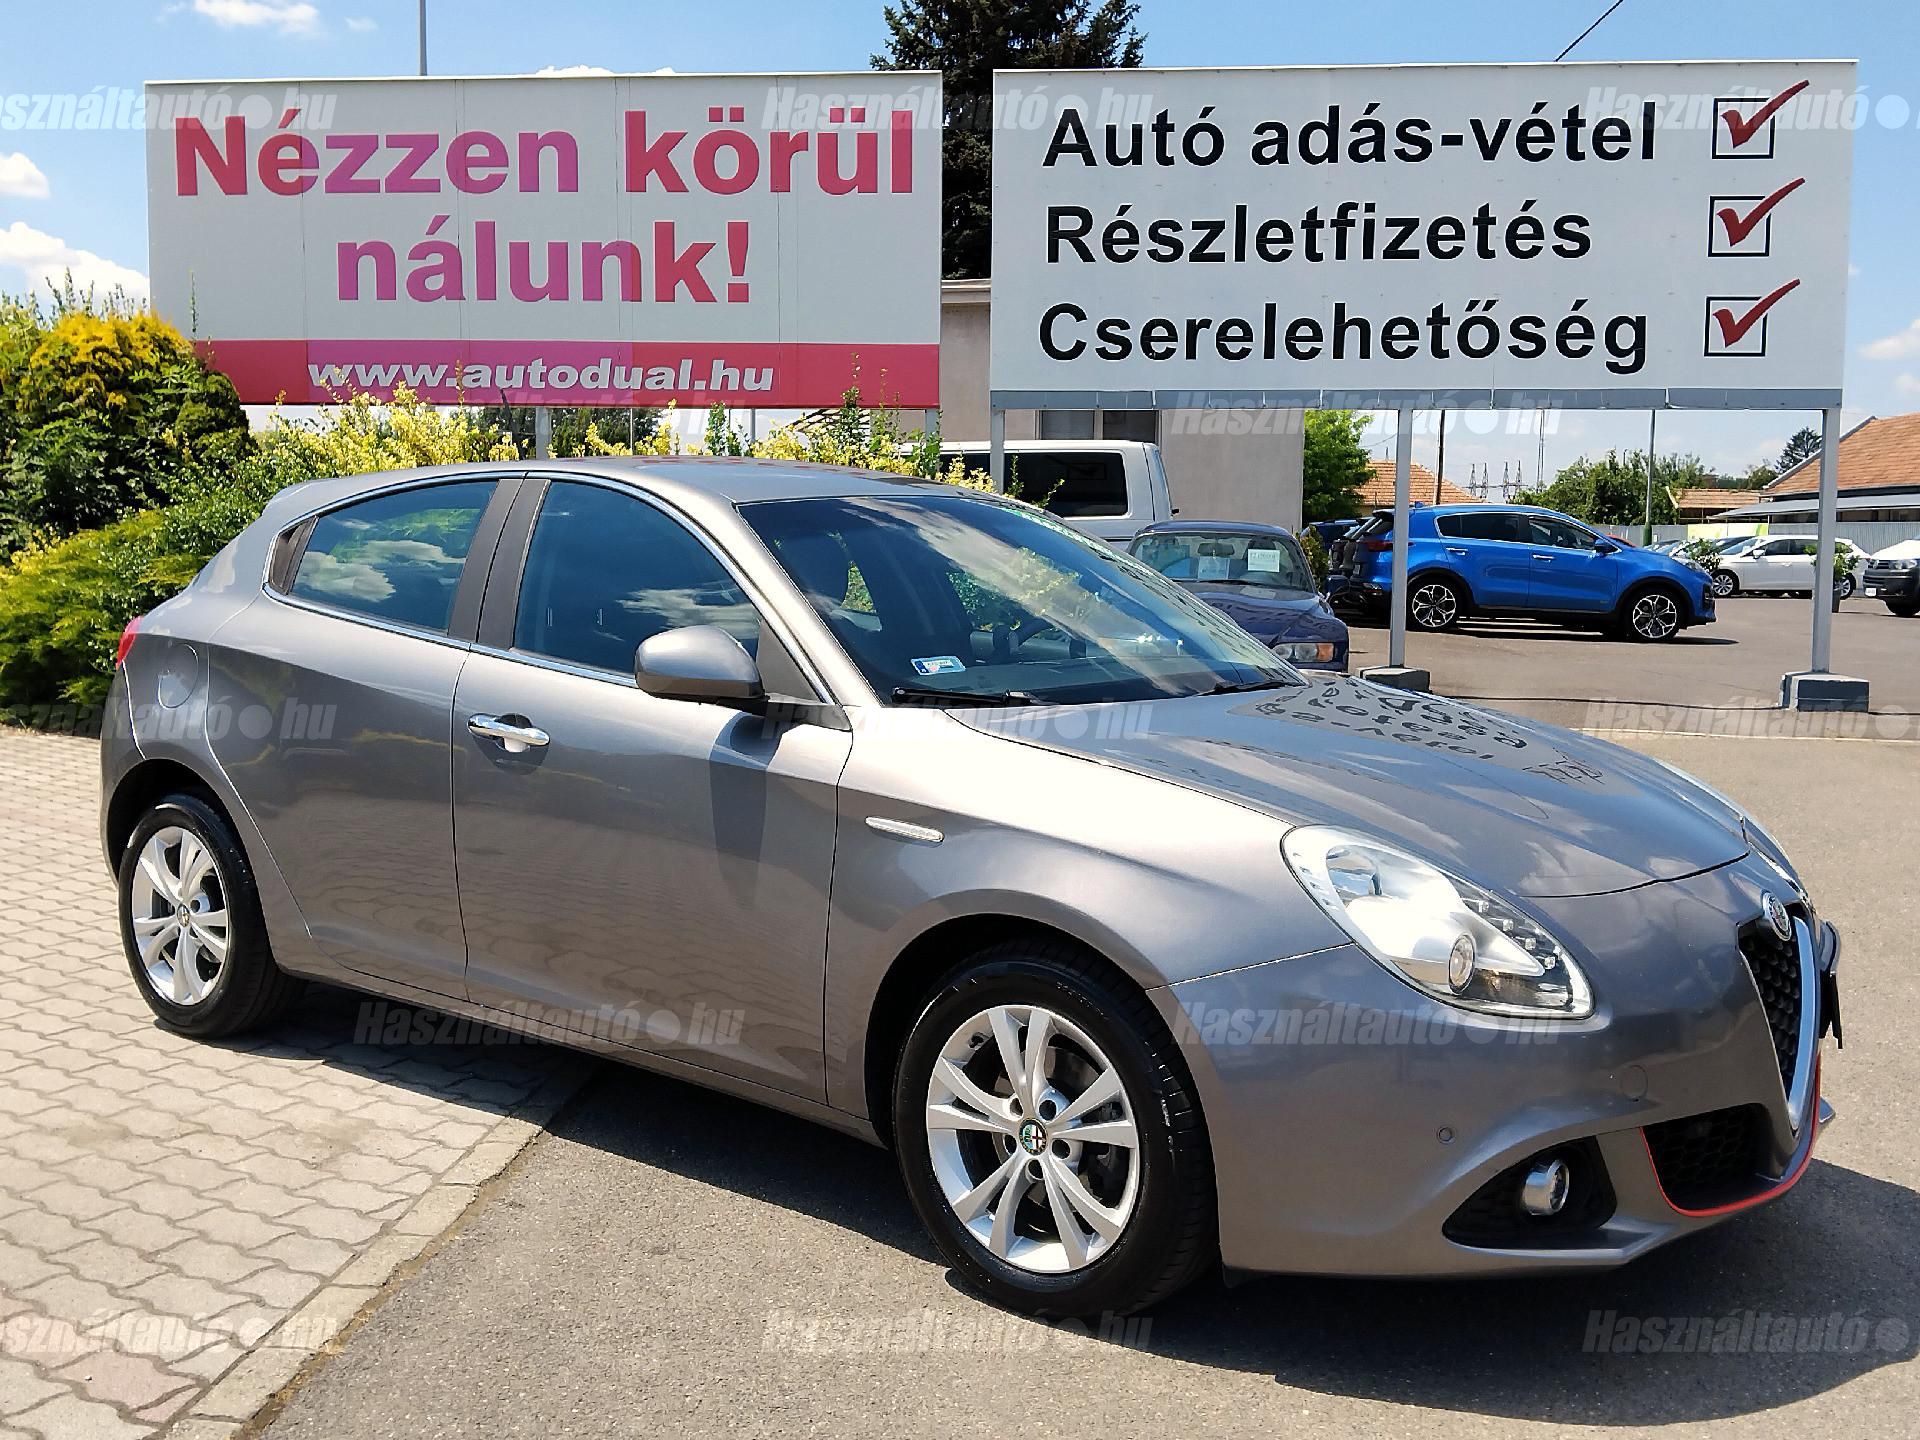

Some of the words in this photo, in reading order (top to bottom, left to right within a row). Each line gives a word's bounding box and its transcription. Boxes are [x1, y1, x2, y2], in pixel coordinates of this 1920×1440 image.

[174, 107, 580, 197] Nézzen
[624, 105, 914, 196] körül
[1041, 105, 1227, 168] Autó
[1250, 101, 1657, 166] adás-vétel
[336, 213, 750, 304] nálunk!
[1046, 199, 1593, 264] Részletfizetés
[1038, 298, 1648, 375] Cserelehetőség
[307, 357, 775, 391] www.autodual.hu
